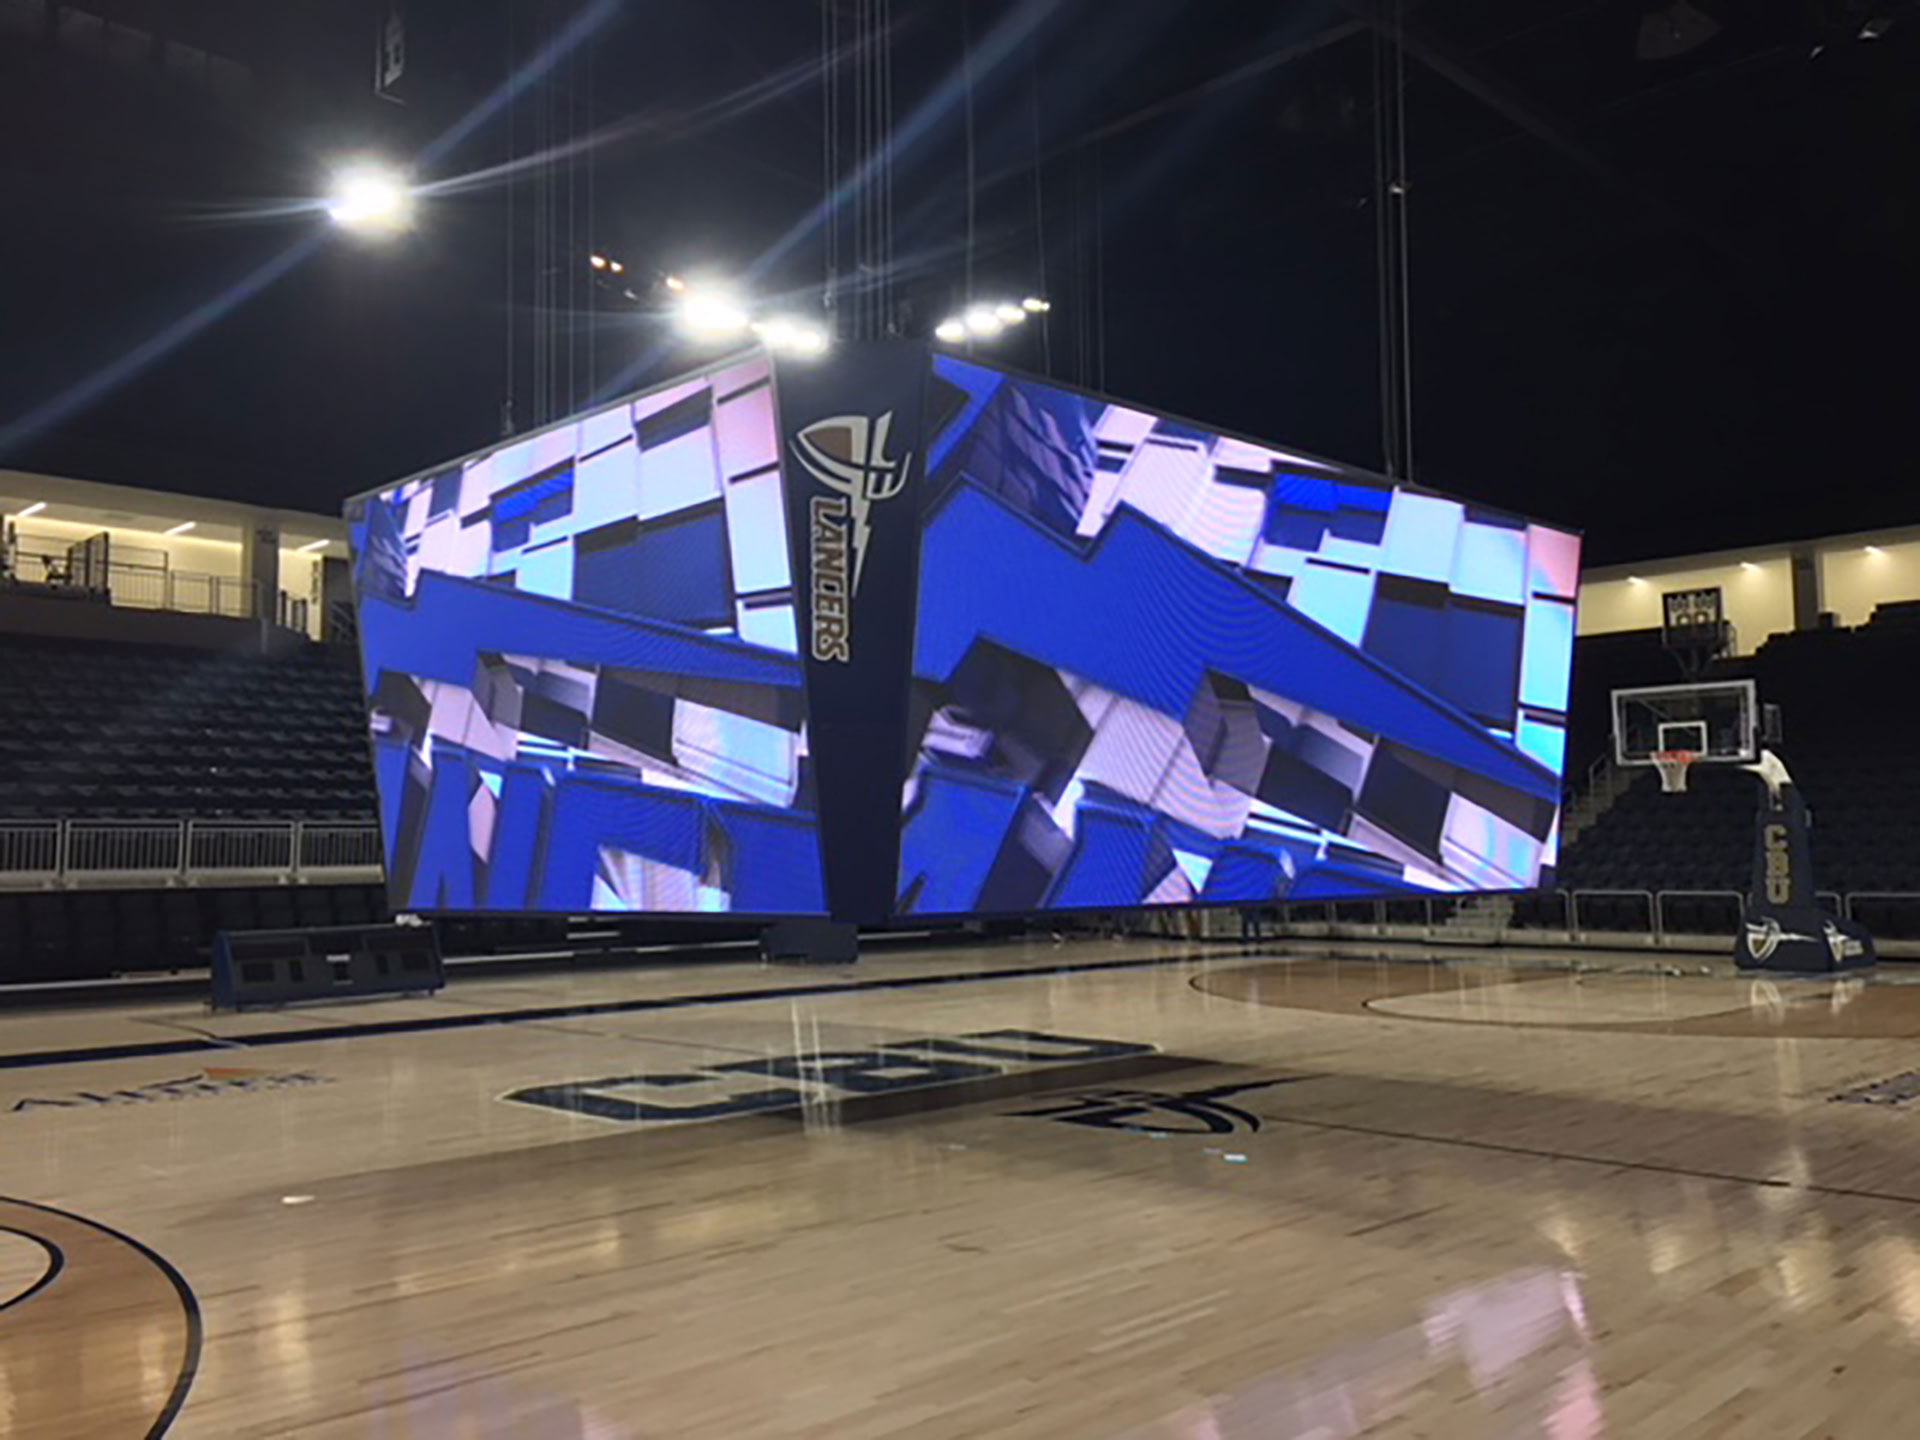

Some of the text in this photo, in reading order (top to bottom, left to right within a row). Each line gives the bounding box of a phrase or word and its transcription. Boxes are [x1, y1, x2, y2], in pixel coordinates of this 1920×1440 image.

[810, 496, 850, 662] LANCERS
[1763, 824, 1791, 904] CBU
[495, 1028, 1163, 1122] CBU
